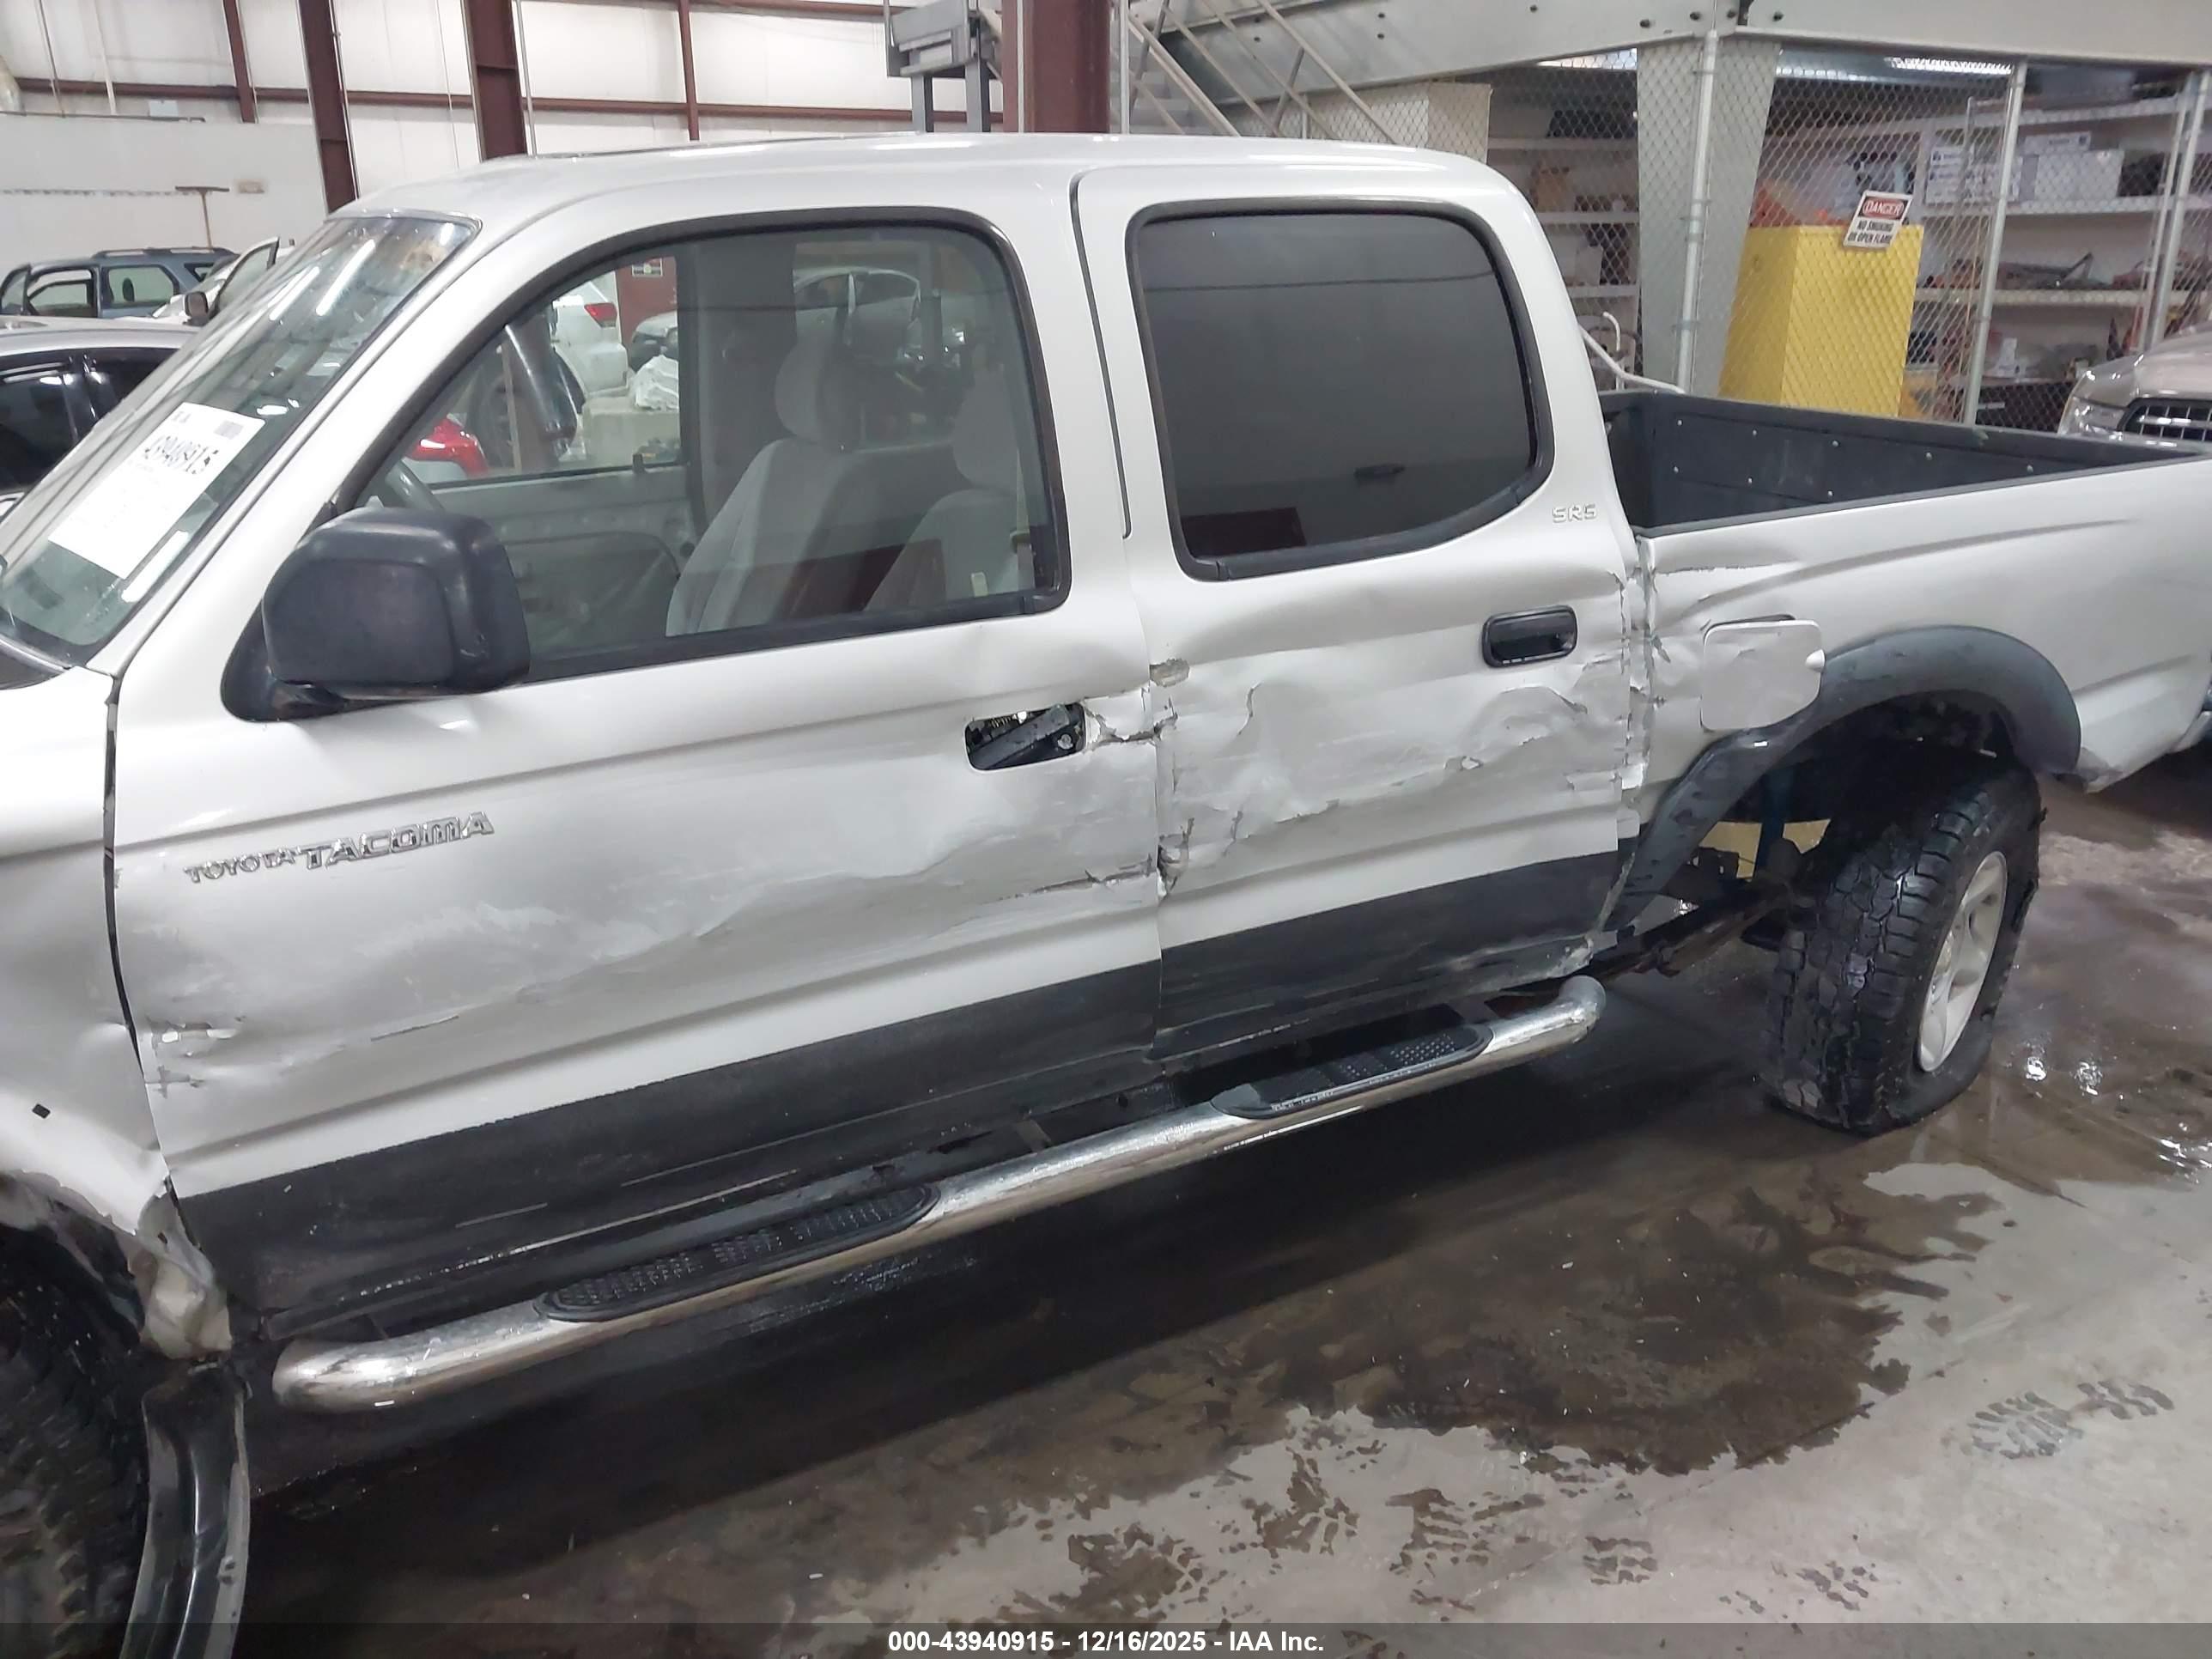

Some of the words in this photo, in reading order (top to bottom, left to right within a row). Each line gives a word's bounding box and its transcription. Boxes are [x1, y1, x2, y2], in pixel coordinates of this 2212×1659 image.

[1864, 200, 1903, 216] DANGER
[185, 847, 297, 884] TOYOTA
[297, 811, 495, 871] TACOMA
